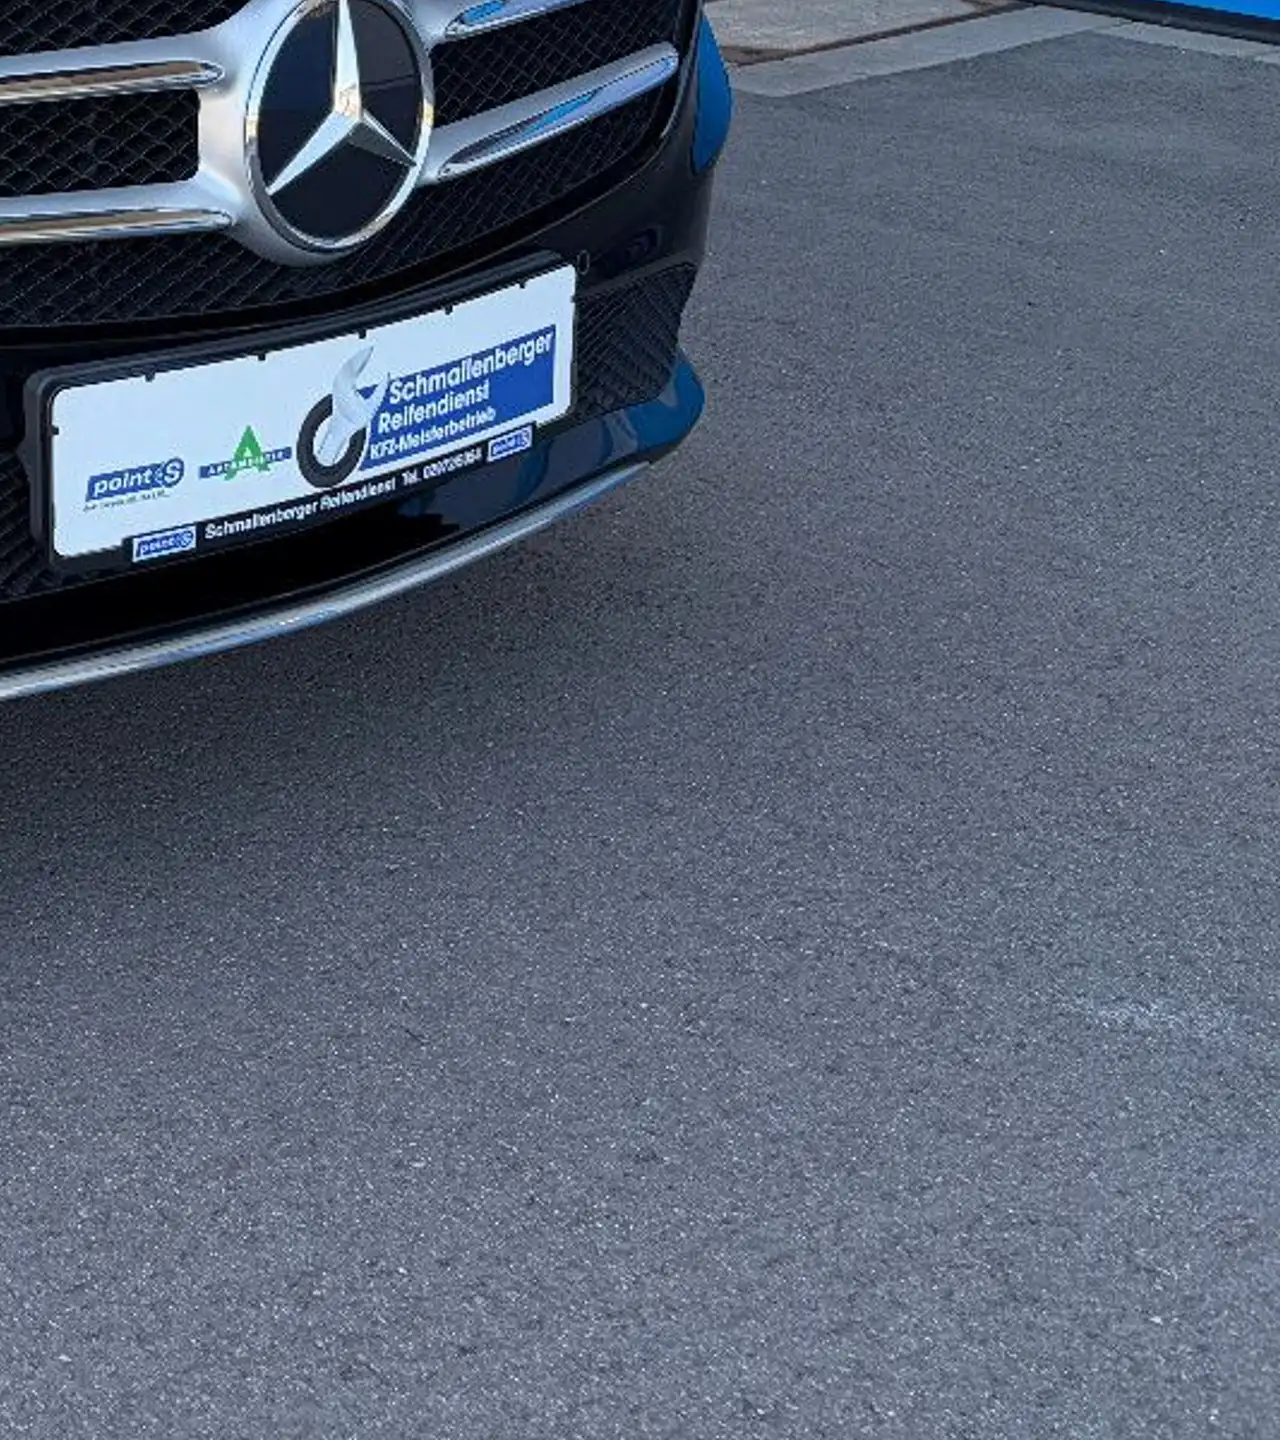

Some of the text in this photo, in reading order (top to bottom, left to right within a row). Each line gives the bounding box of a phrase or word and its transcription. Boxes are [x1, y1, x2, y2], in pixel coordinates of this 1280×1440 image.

[390, 333, 552, 404] Schmallenberger
[378, 381, 490, 434] Reifendienst
[205, 500, 318, 538] Schmallenberger
